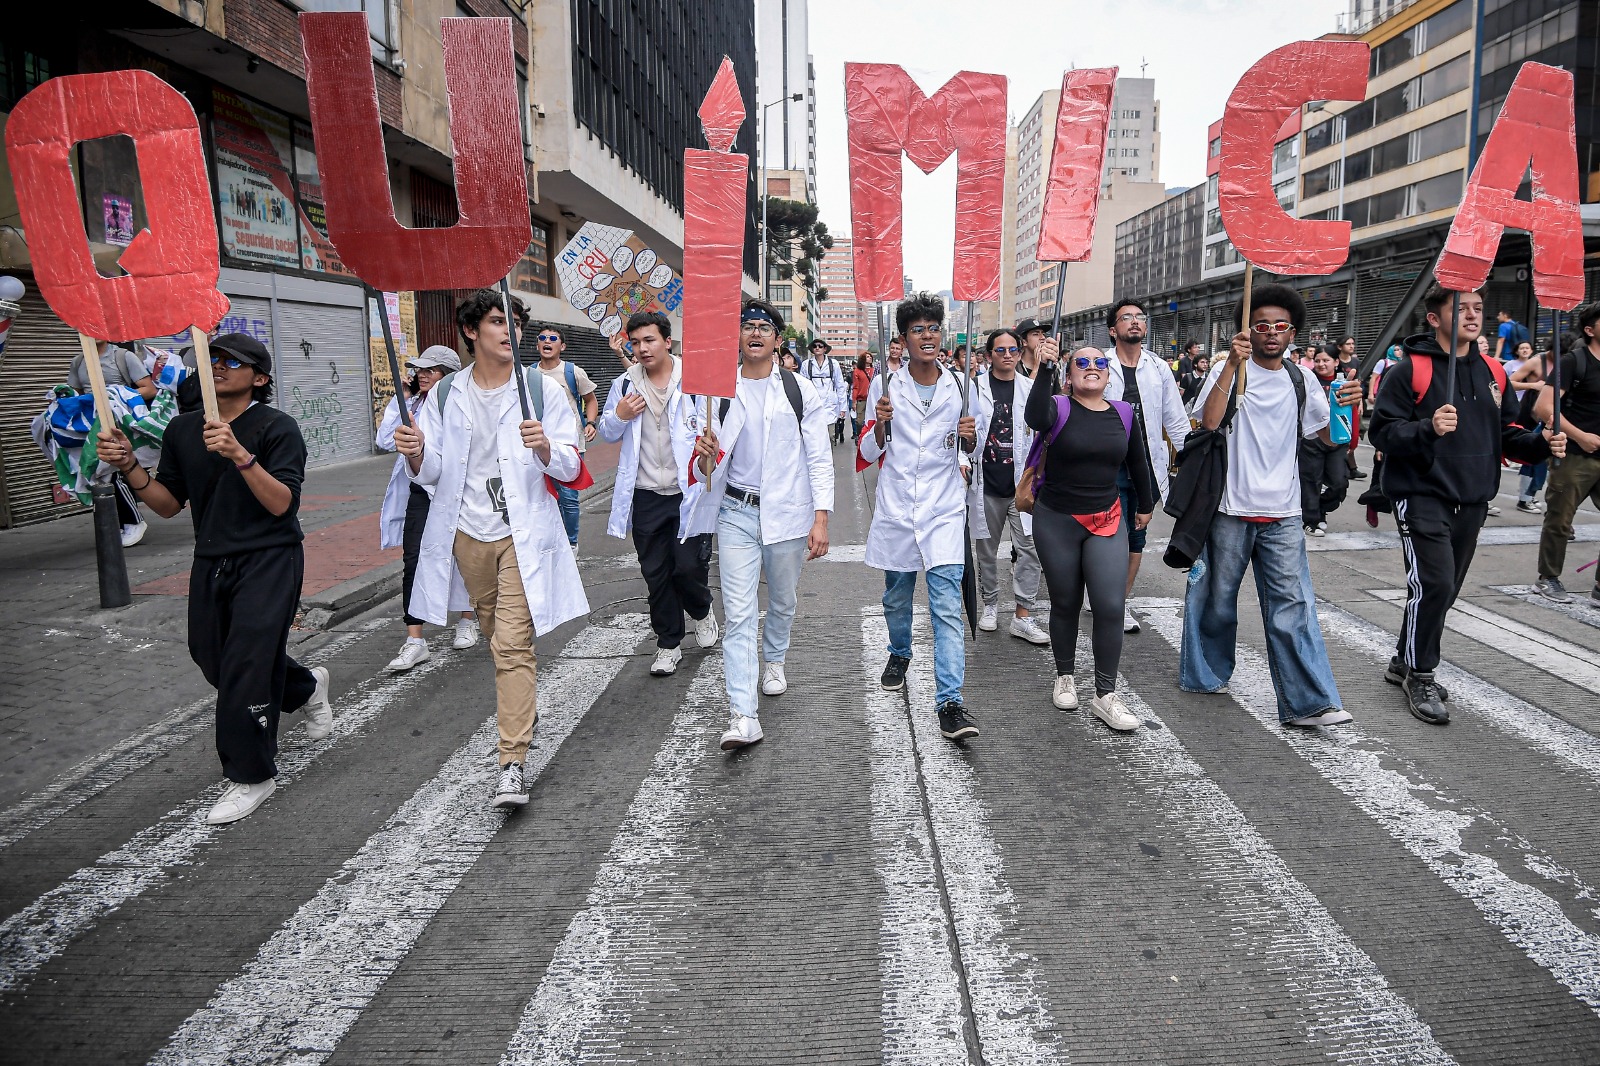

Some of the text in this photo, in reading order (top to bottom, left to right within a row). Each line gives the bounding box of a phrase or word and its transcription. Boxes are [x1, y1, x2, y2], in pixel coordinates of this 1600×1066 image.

[5, 69, 230, 343] Q
[299, 11, 532, 291] U
[845, 61, 1008, 303] M
[1036, 65, 1120, 263] I
[1219, 39, 1371, 276] C
[1433, 61, 1586, 311] A
[235, 230, 275, 251] seguridad
[561, 235, 593, 266] EN LA
[577, 247, 610, 280] CRU
[657, 277, 683, 303] CAMA
[665, 285, 684, 312] GENT
[291, 386, 343, 420] Somos
[300, 418, 342, 458] egión
